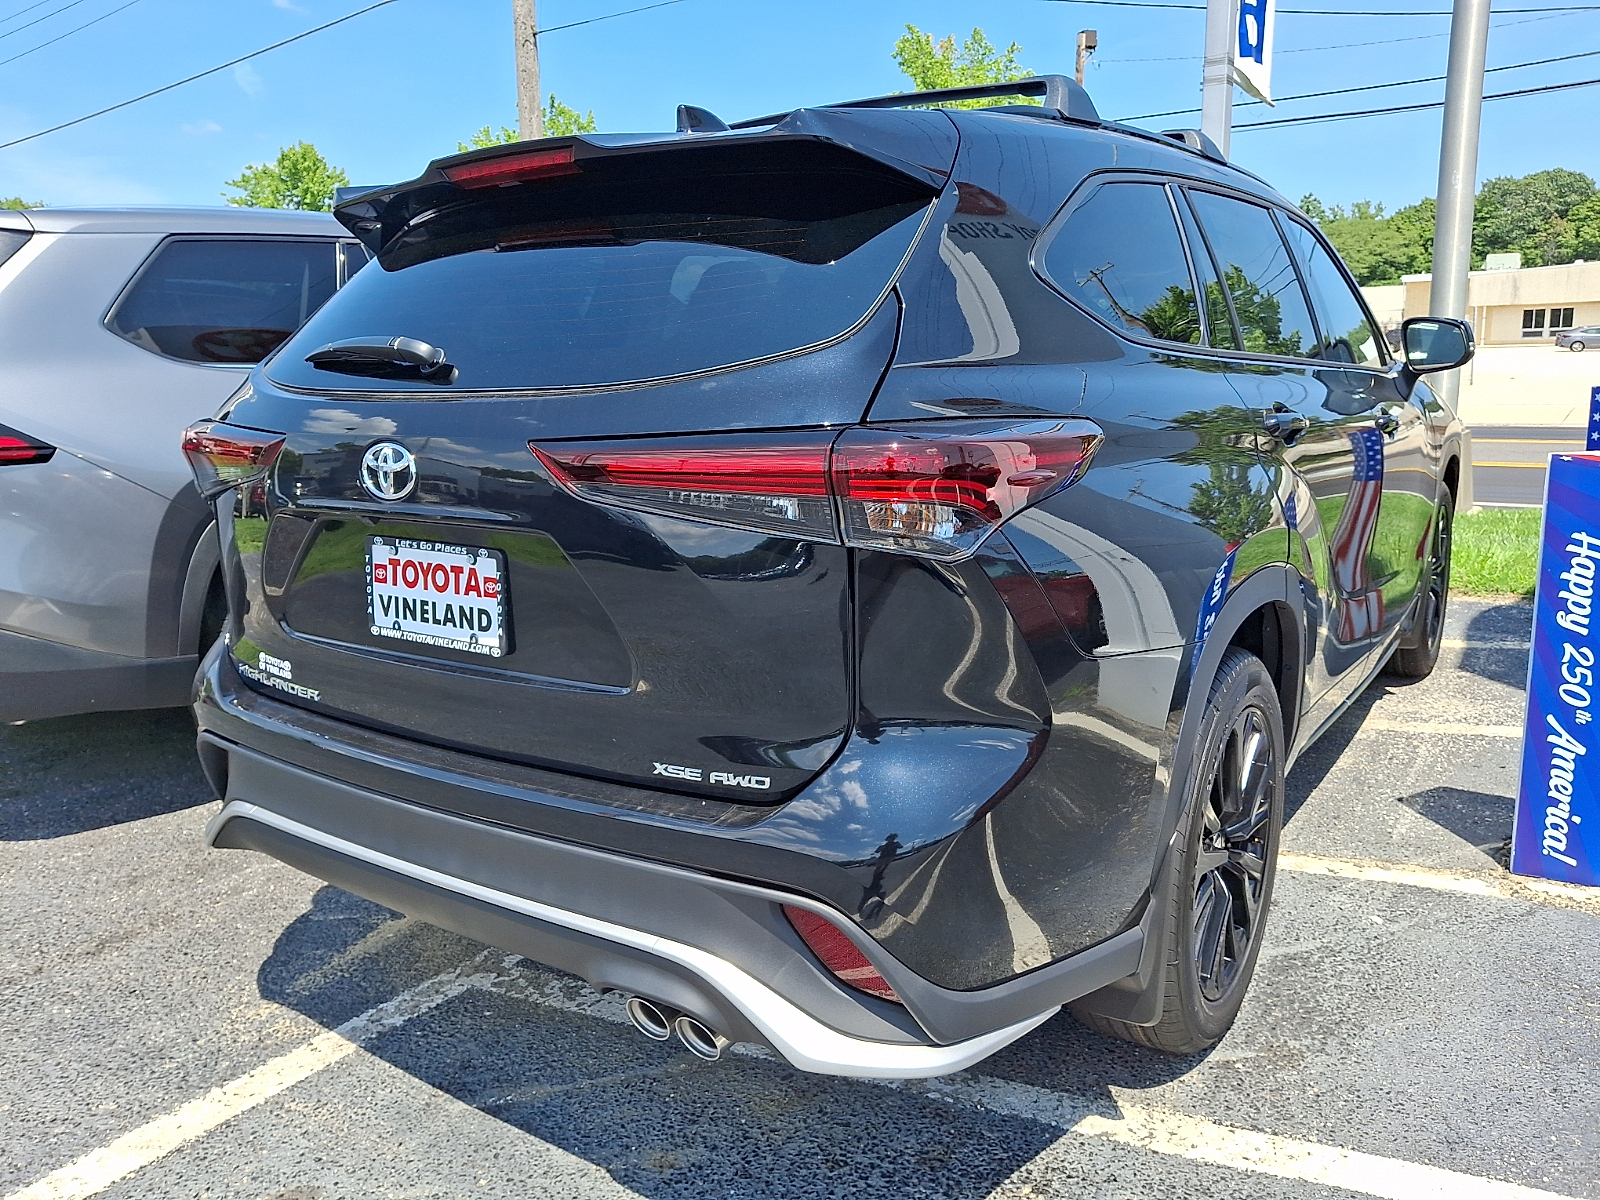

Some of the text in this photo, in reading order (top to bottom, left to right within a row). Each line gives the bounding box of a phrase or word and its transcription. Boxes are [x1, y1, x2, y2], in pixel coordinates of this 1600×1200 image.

[395, 538, 468, 555] Let's Go Places
[364, 554, 373, 615] TOYOTA
[388, 557, 483, 598] TOYOTA
[1556, 531, 1600, 636] Happy
[378, 593, 493, 633] VINELAND
[495, 571, 503, 636] TOYOTA
[380, 627, 490, 656] WWW.TOYOTAVINELAND.COM
[238, 663, 321, 702] HIGHLANDER
[652, 761, 771, 790] XSE AWD
[1542, 713, 1587, 867] America!
